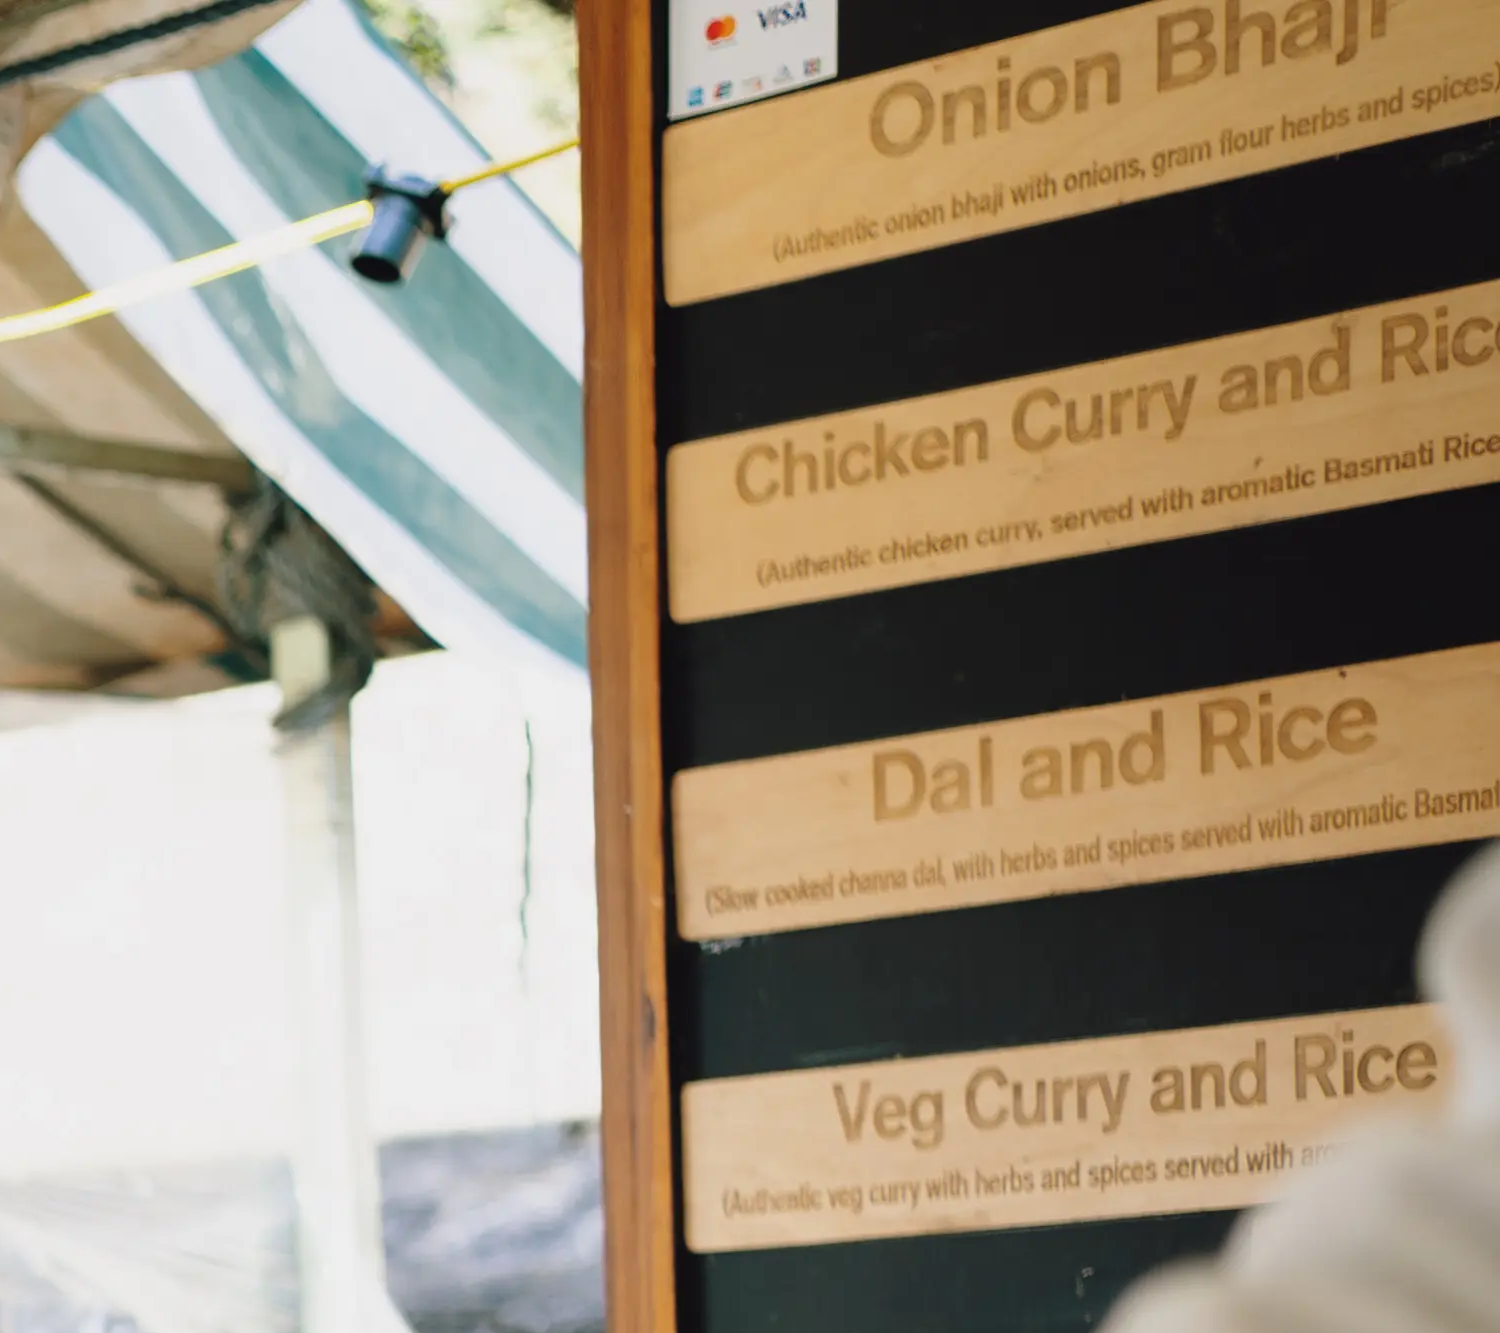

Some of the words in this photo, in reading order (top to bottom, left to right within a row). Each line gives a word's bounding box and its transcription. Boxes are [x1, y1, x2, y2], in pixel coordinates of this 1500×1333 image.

[756, 0, 808, 31] VISA
[868, 56, 1121, 158] Onion
[772, 215, 879, 263] (Authentic
[884, 201, 945, 234] onion
[952, 184, 1004, 220] bhaji
[1009, 171, 1058, 206] with
[1063, 155, 1146, 194] onions,
[1152, 140, 1212, 177] gram
[1220, 126, 1274, 157] flour
[1282, 105, 1350, 142] herbs
[1358, 88, 1404, 123] and
[734, 419, 989, 506] Chicken
[1011, 374, 1197, 454] Curry
[1218, 325, 1352, 415] and
[1381, 305, 1500, 384] Ric
[756, 543, 872, 588] (Authentic
[878, 530, 969, 564] chicken
[975, 515, 1043, 549] curry,
[1050, 496, 1133, 536] served
[1140, 486, 1194, 517] with
[1201, 465, 1316, 507] aromatic
[1324, 440, 1434, 484] Basmati
[1443, 432, 1500, 462] Rice
[871, 734, 994, 822] Dal
[1019, 709, 1166, 802] and
[1199, 690, 1378, 776] Rice
[763, 870, 834, 908] cooked
[838, 868, 908, 899] channa
[952, 850, 995, 883] with
[1000, 840, 1058, 877] herbs
[1064, 836, 1101, 869] and
[1107, 829, 1176, 867] spices
[1181, 814, 1252, 852] served
[1257, 808, 1304, 841] with
[1309, 794, 1408, 834] aromatic
[1414, 779, 1500, 819] Basmat
[833, 1079, 945, 1151] Veg
[964, 1065, 1130, 1134] Curry
[1150, 1038, 1268, 1114] and
[1294, 1028, 1438, 1101] Rice
[721, 1182, 823, 1218] (Authentic
[828, 1184, 863, 1214] veg
[870, 1180, 920, 1210] curry
[925, 1169, 968, 1200] with
[975, 1164, 1035, 1196] herbs
[1041, 1159, 1080, 1192] and
[1088, 1154, 1157, 1192] spices
[1164, 1146, 1240, 1181] served
[1245, 1141, 1294, 1175] with
